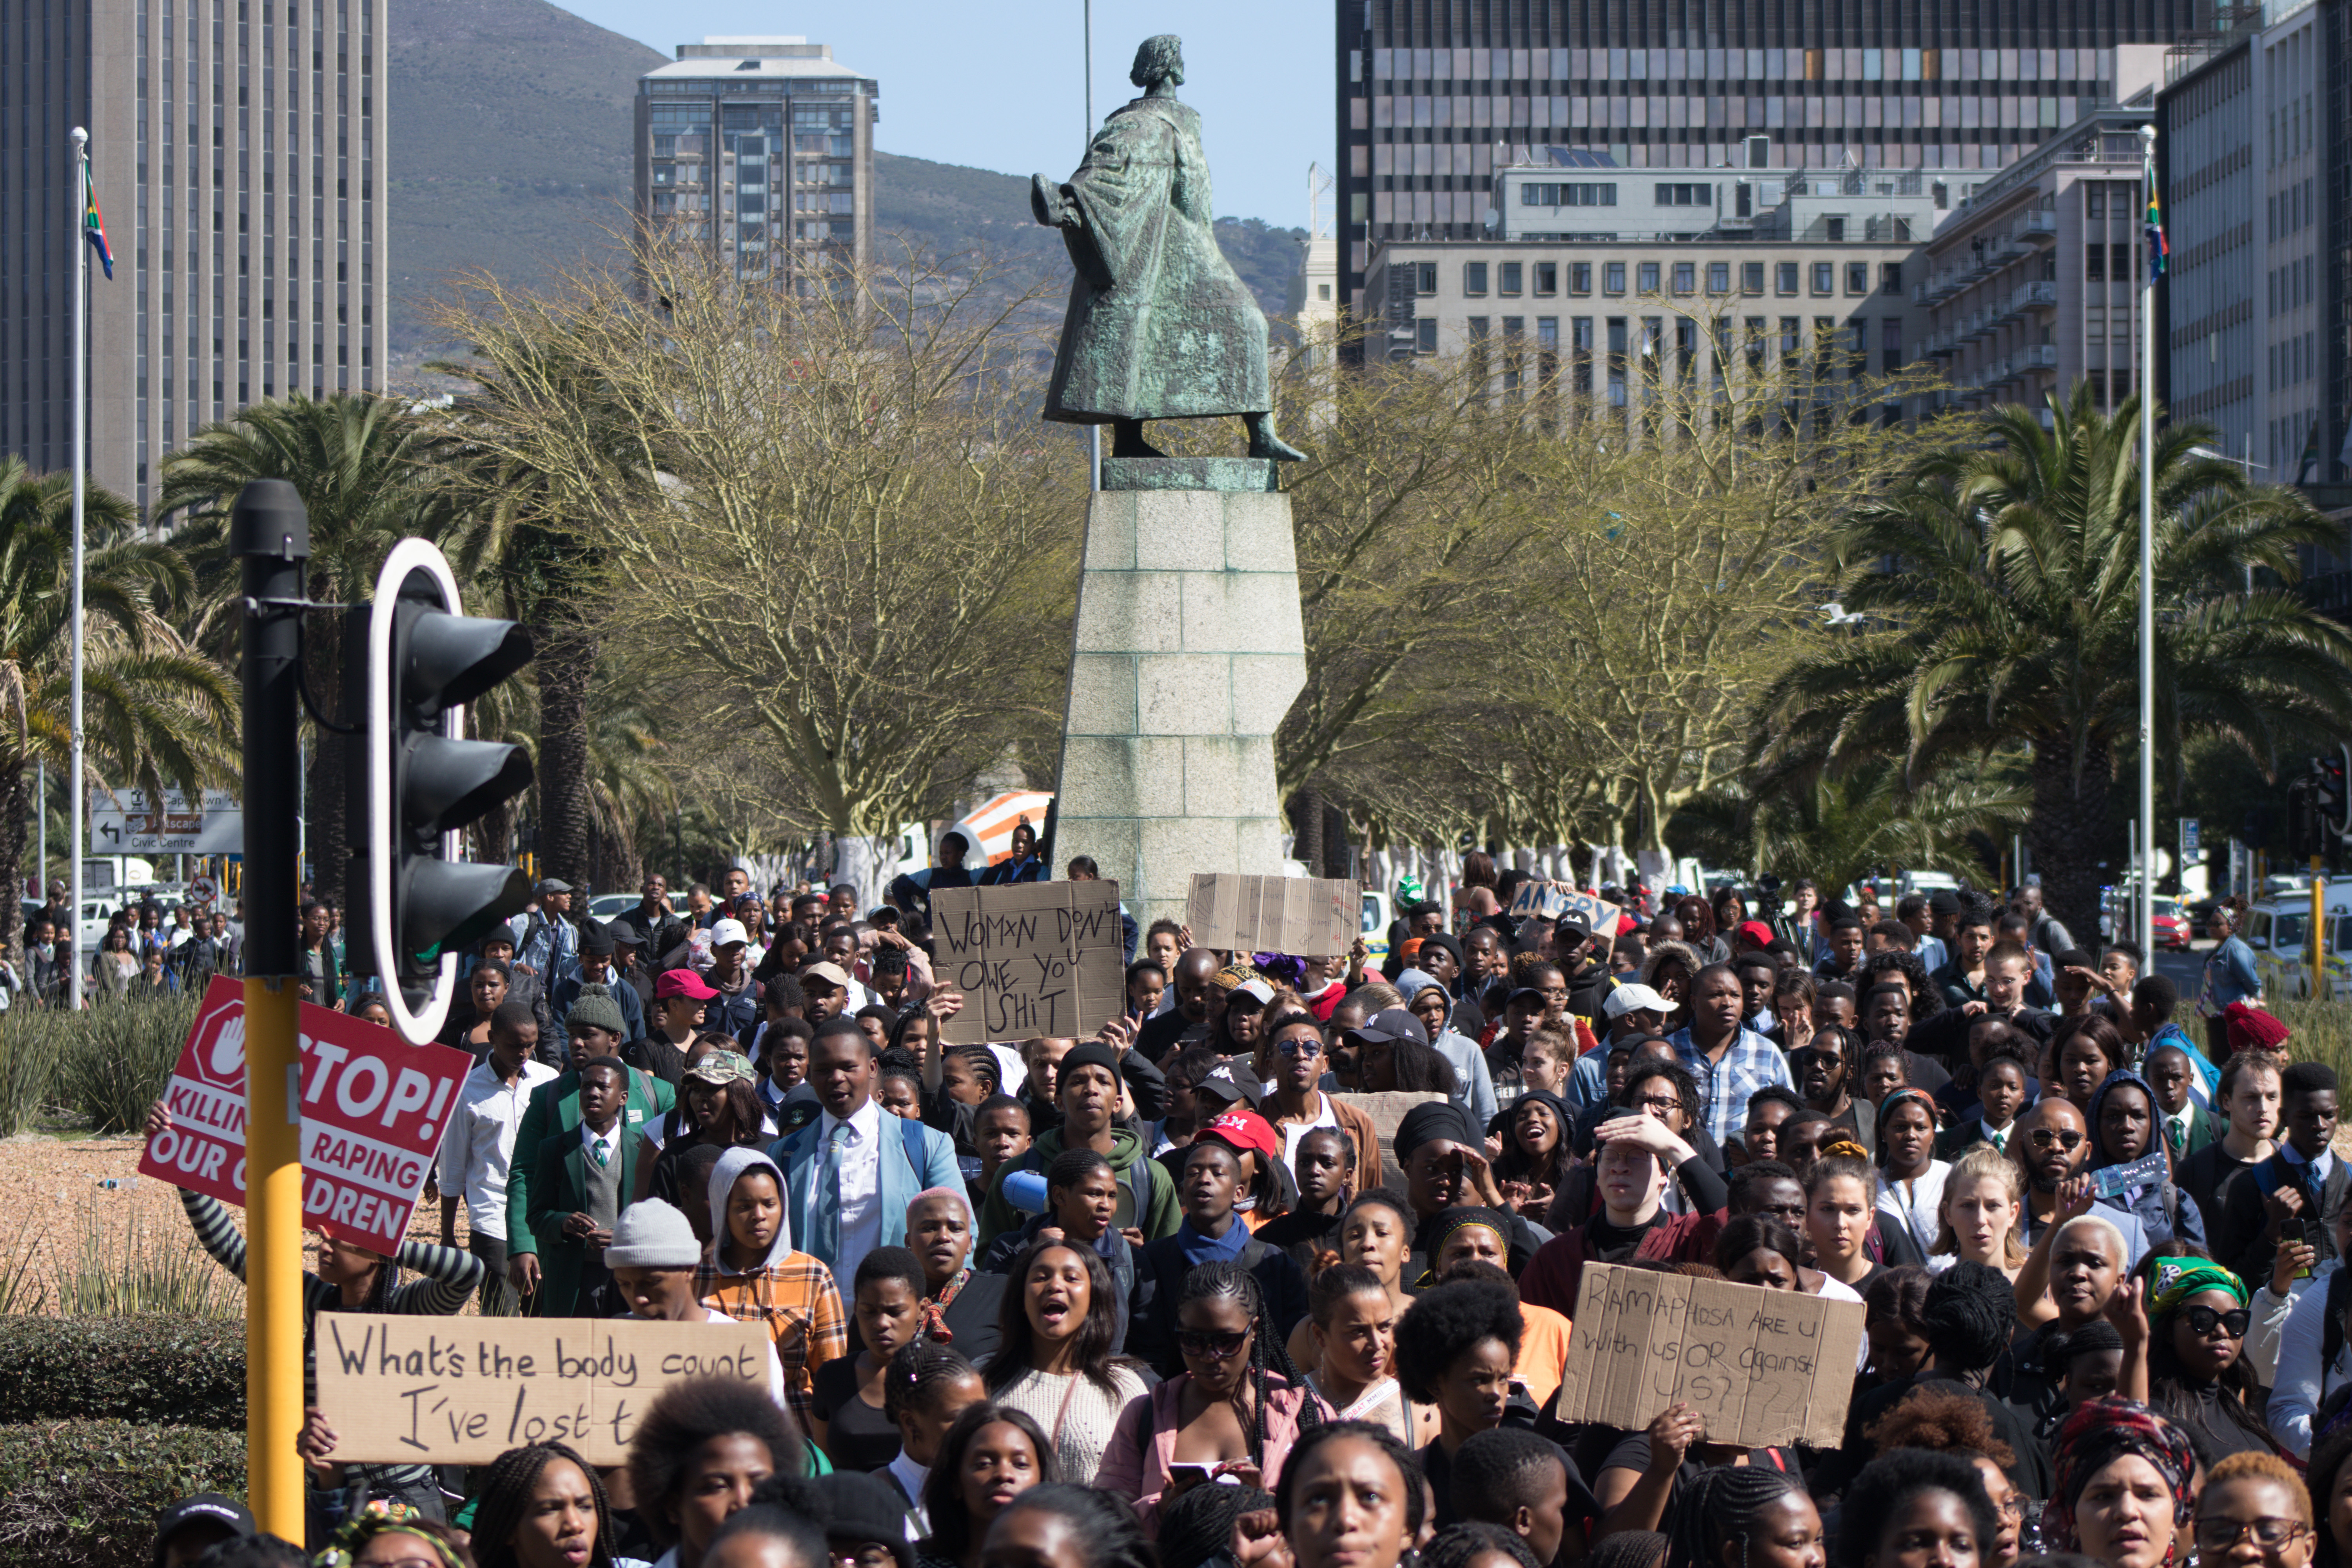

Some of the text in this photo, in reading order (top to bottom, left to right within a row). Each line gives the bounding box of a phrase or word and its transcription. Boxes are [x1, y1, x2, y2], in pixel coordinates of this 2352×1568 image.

[132, 838, 195, 848] Civic Centre
[1561, 915, 1583, 924] FILA
[960, 959, 1020, 994] OWE
[151, 1130, 227, 1181] OUR
[311, 1132, 421, 1189] RAPING
[1748, 1310, 1788, 1334] ARE
[330, 1319, 759, 1386] What's the body count
[1686, 1341, 1729, 1371] OR
[400, 1384, 488, 1452] I've
[508, 1384, 590, 1443] lost
